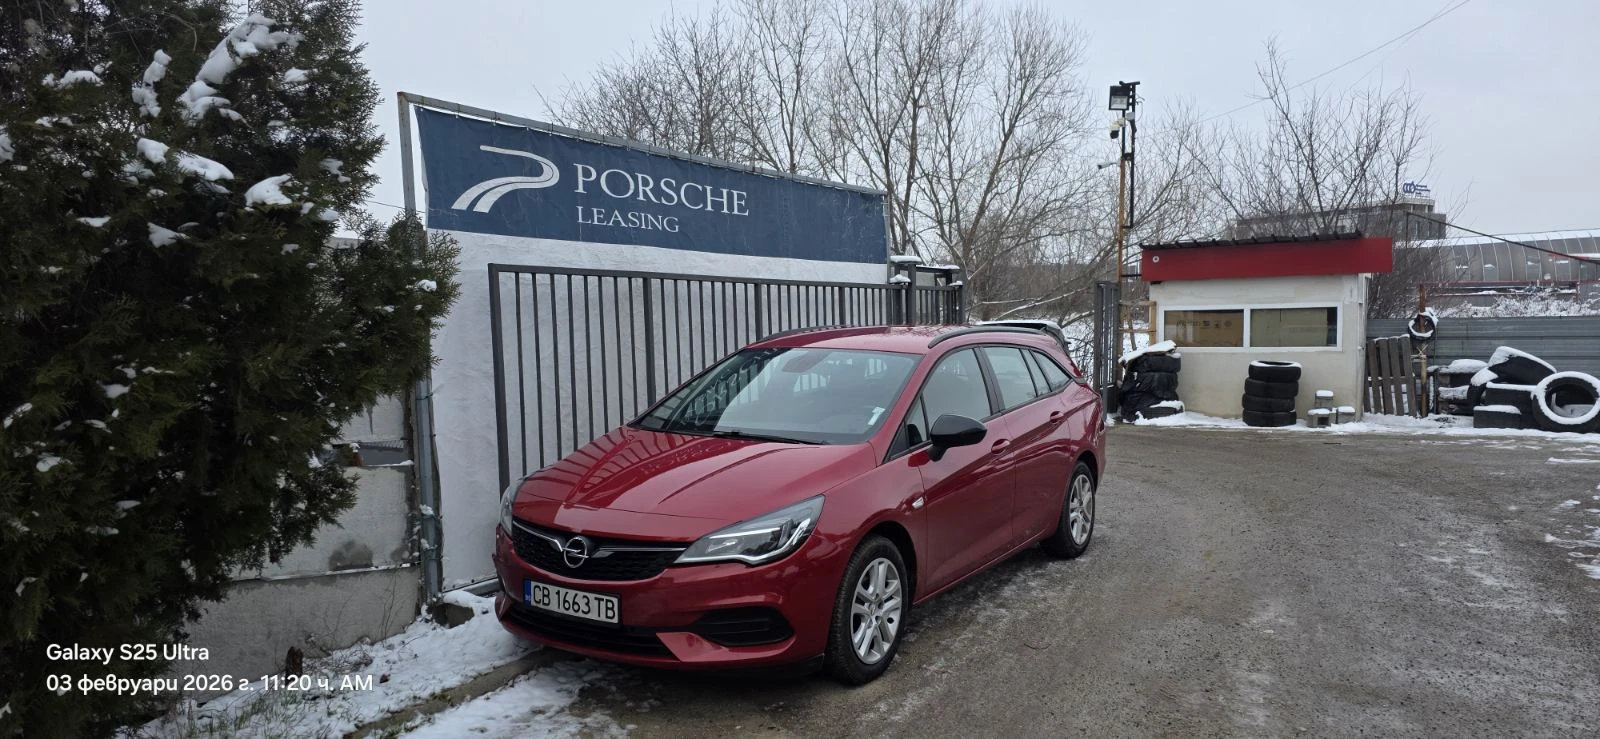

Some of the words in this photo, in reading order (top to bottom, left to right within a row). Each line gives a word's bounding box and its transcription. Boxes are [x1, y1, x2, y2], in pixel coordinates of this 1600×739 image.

[574, 164, 749, 216] PORSCHE
[576, 206, 679, 233] LEASING
[533, 585, 551, 607] CB
[555, 590, 591, 615] 1663
[594, 597, 615, 619] TB
